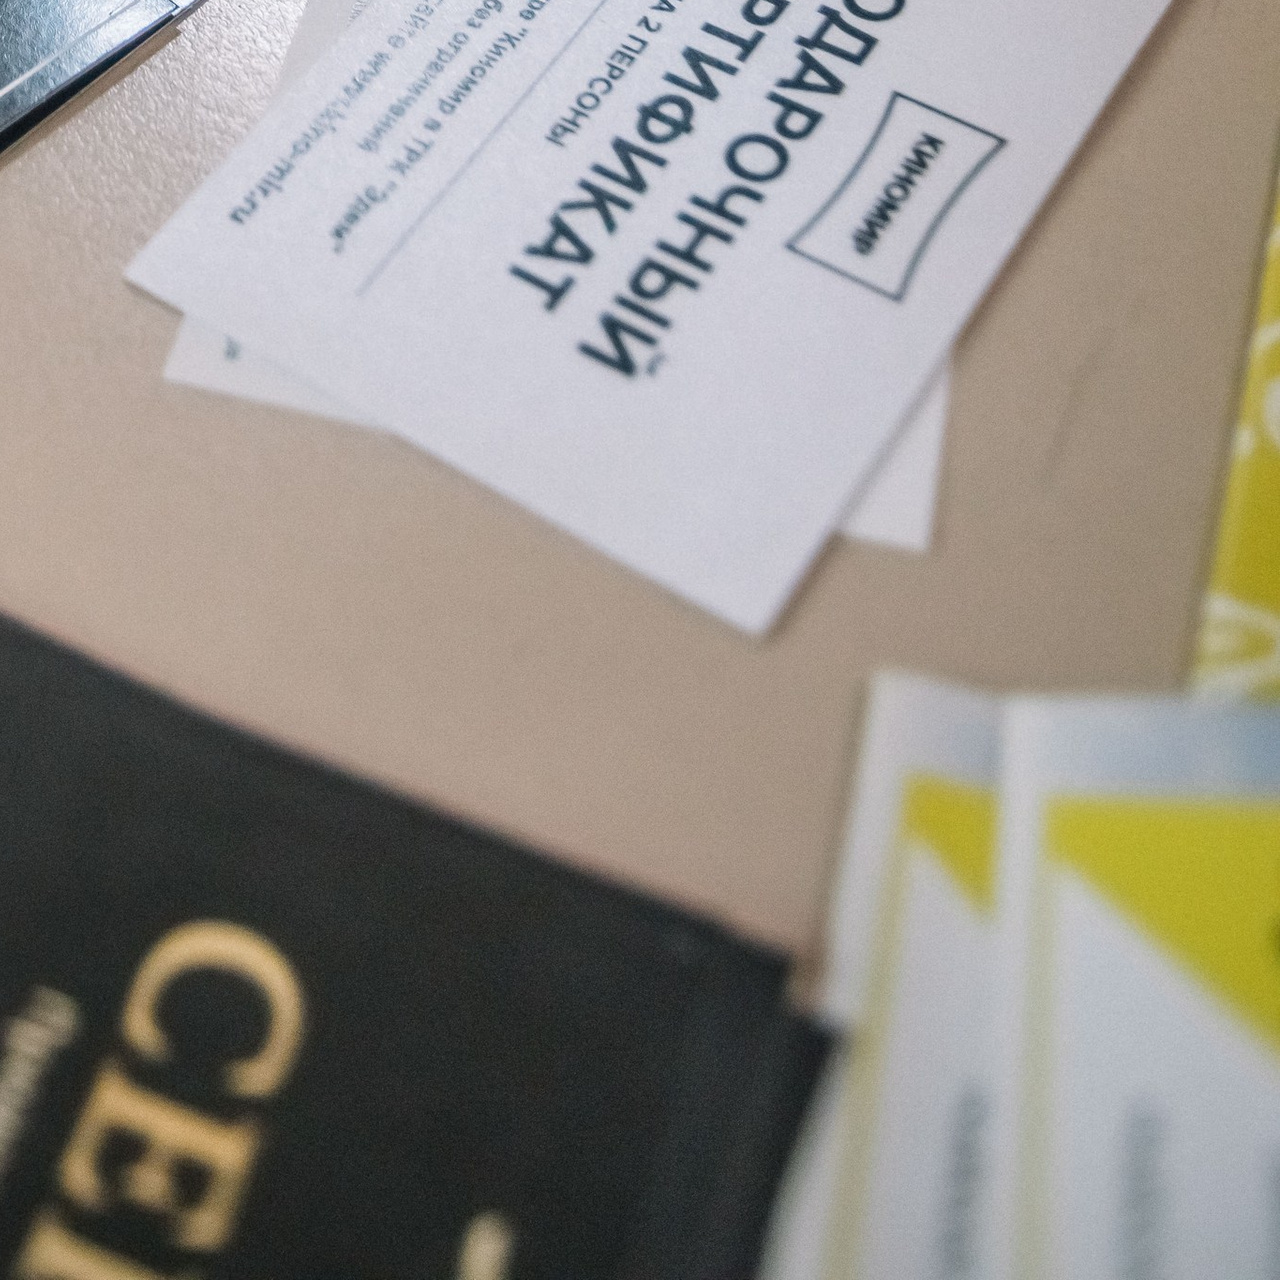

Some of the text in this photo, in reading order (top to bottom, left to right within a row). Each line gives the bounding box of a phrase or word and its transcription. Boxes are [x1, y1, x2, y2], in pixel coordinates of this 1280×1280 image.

[636, 15, 663, 34] 2
[358, 31, 469, 153] ограничений
[546, 33, 649, 147] ПЕРСОНЫ
[391, 139, 432, 176] ТРК
[855, 134, 942, 254] КИНОМИР
